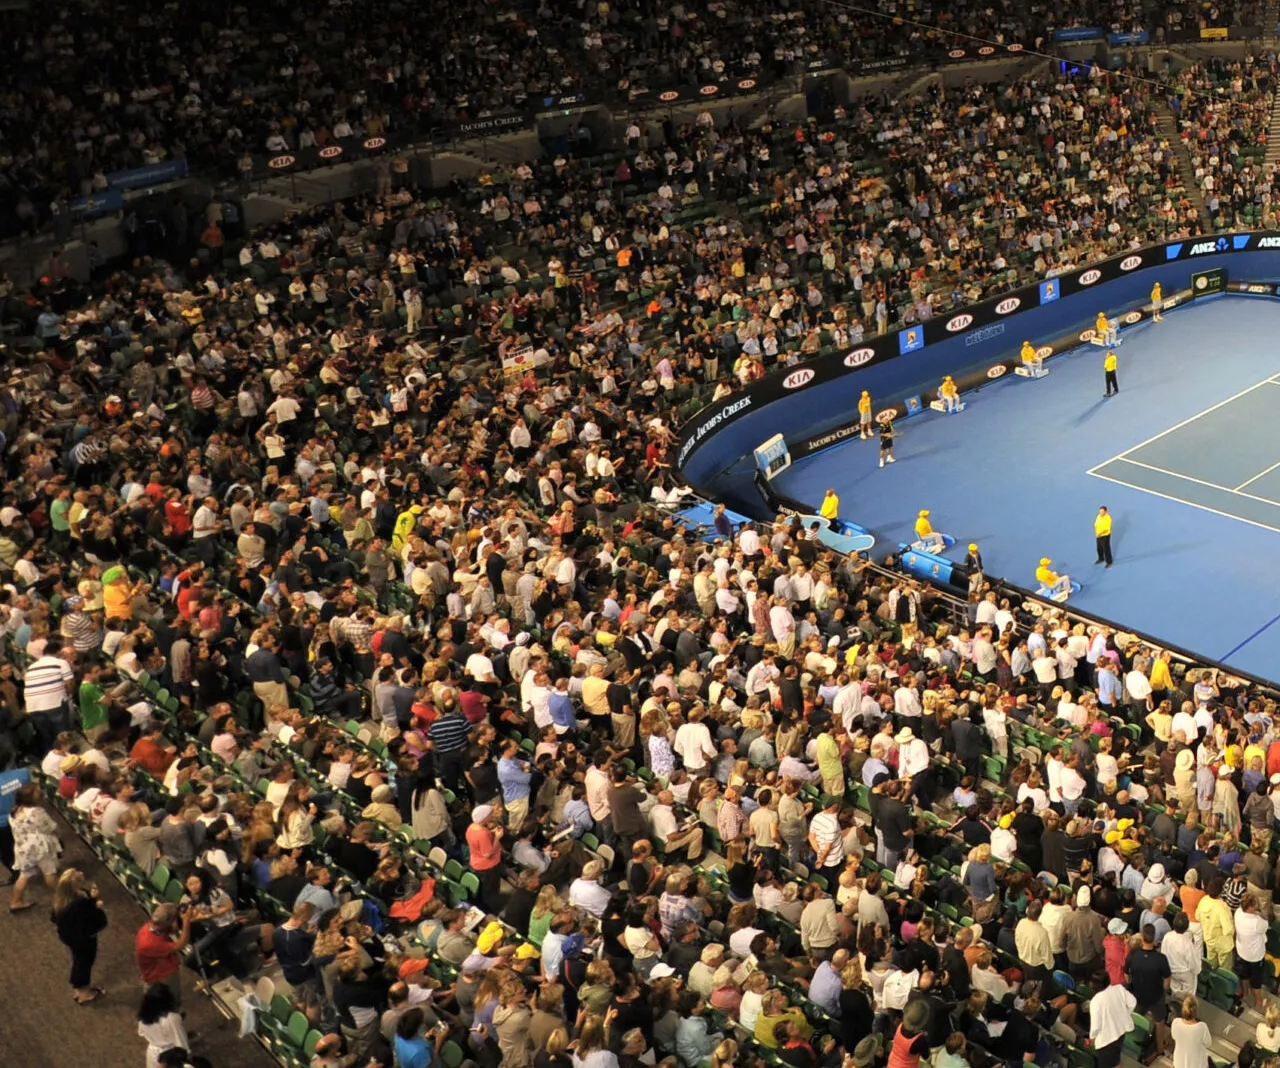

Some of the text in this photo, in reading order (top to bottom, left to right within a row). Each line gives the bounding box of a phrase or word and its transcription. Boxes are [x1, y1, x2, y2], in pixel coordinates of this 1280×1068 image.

[494, 116, 524, 126] CREEK
[366, 137, 383, 146] KIA
[322, 146, 340, 156] KIA
[272, 156, 291, 167] KIA
[1190, 242, 1216, 256] ANZ
[1123, 256, 1139, 268] KIA
[1082, 272, 1098, 283] KIA
[1000, 300, 1017, 312] KIA
[950, 316, 969, 330] KIA
[850, 351, 870, 364] KIA
[990, 366, 1004, 377] KIA
[788, 371, 810, 386] KIA
[697, 395, 752, 440] JACOB'S CREEK
[808, 424, 860, 450] JACOB'S CREEK
